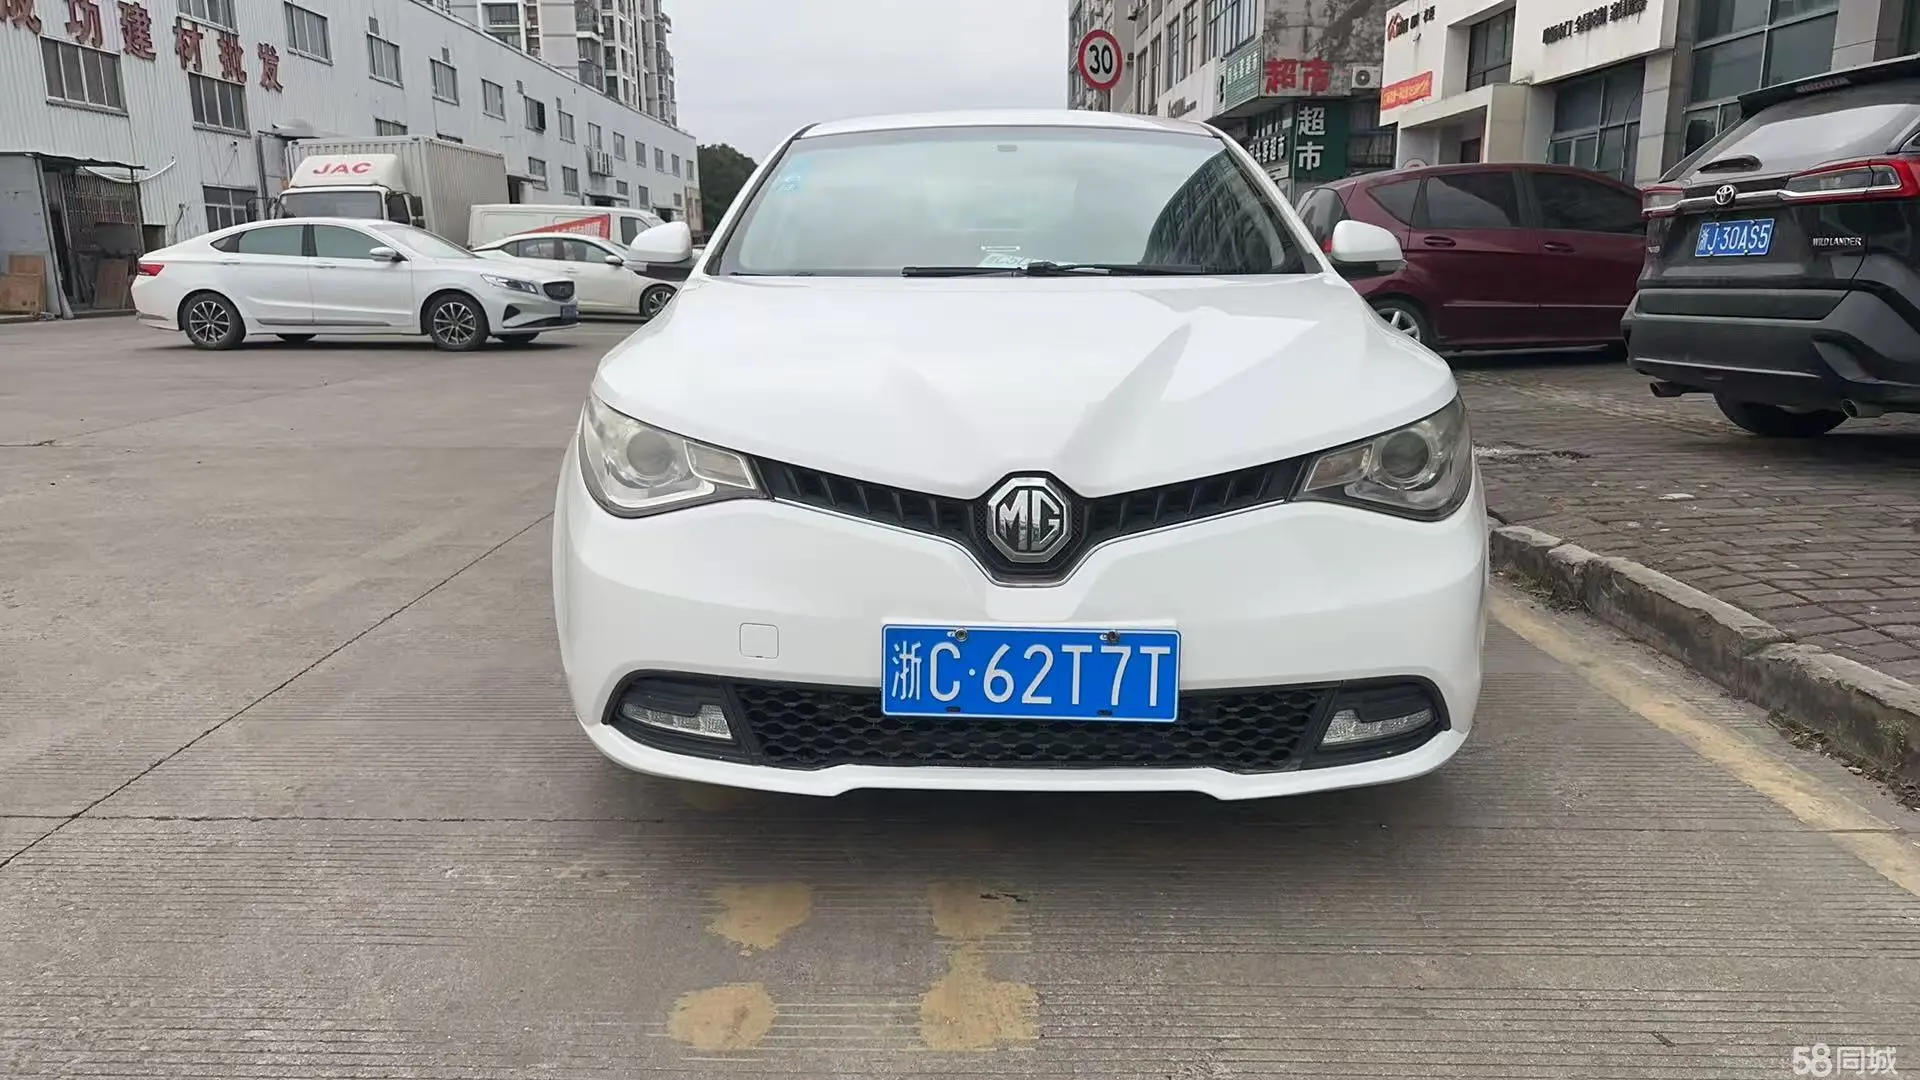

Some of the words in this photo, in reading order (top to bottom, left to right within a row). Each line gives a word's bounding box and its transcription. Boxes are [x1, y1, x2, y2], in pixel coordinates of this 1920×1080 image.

[1089, 44, 1113, 74] 30
[1265, 57, 1332, 94] 超市
[1296, 106, 1325, 170] 超市
[313, 162, 372, 174] JAC
[999, 489, 1061, 551] MG
